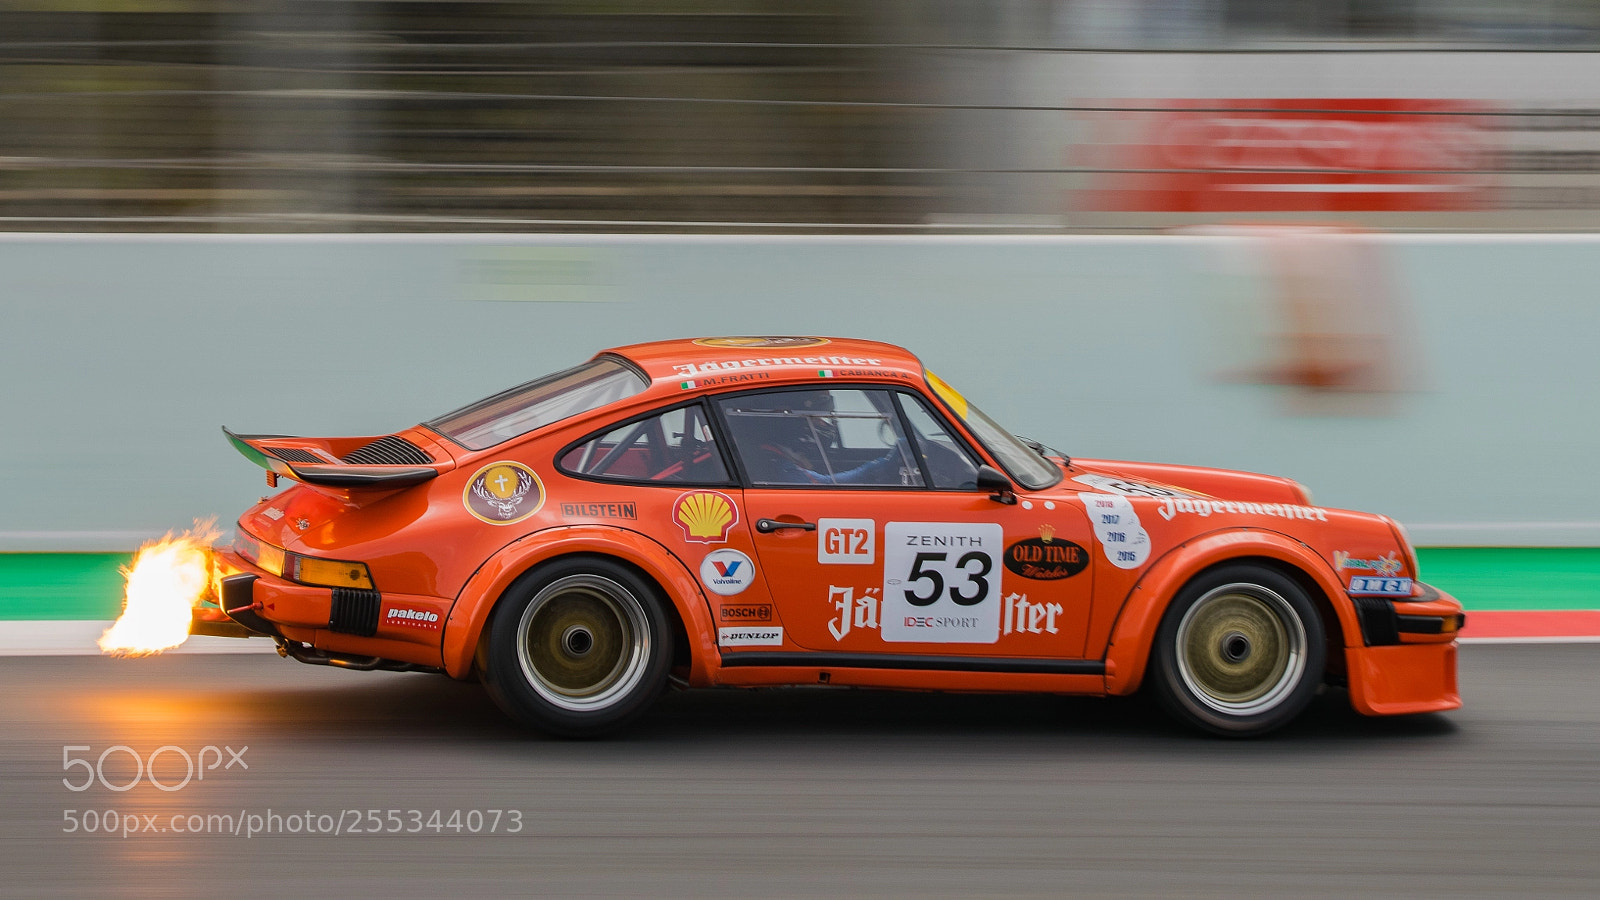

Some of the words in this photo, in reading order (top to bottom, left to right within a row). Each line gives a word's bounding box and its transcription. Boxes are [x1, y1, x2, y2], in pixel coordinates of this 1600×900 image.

[840, 369, 898, 378] CABIANCA
[564, 504, 634, 518] BILSTEIN
[1101, 513, 1120, 524] 2017
[824, 527, 869, 555] GT2
[906, 535, 982, 547] ZENITH
[1106, 531, 1126, 542] 2016
[1012, 544, 1043, 562] OLD
[1044, 546, 1080, 564] TIME
[1117, 550, 1136, 562] 2015
[903, 551, 993, 607] 53
[387, 608, 439, 622] pakelo
[722, 608, 756, 617] BOSCH
[904, 616, 934, 628] IDEC
[935, 617, 979, 628] SPORT
[730, 632, 779, 640] DUNLOP
